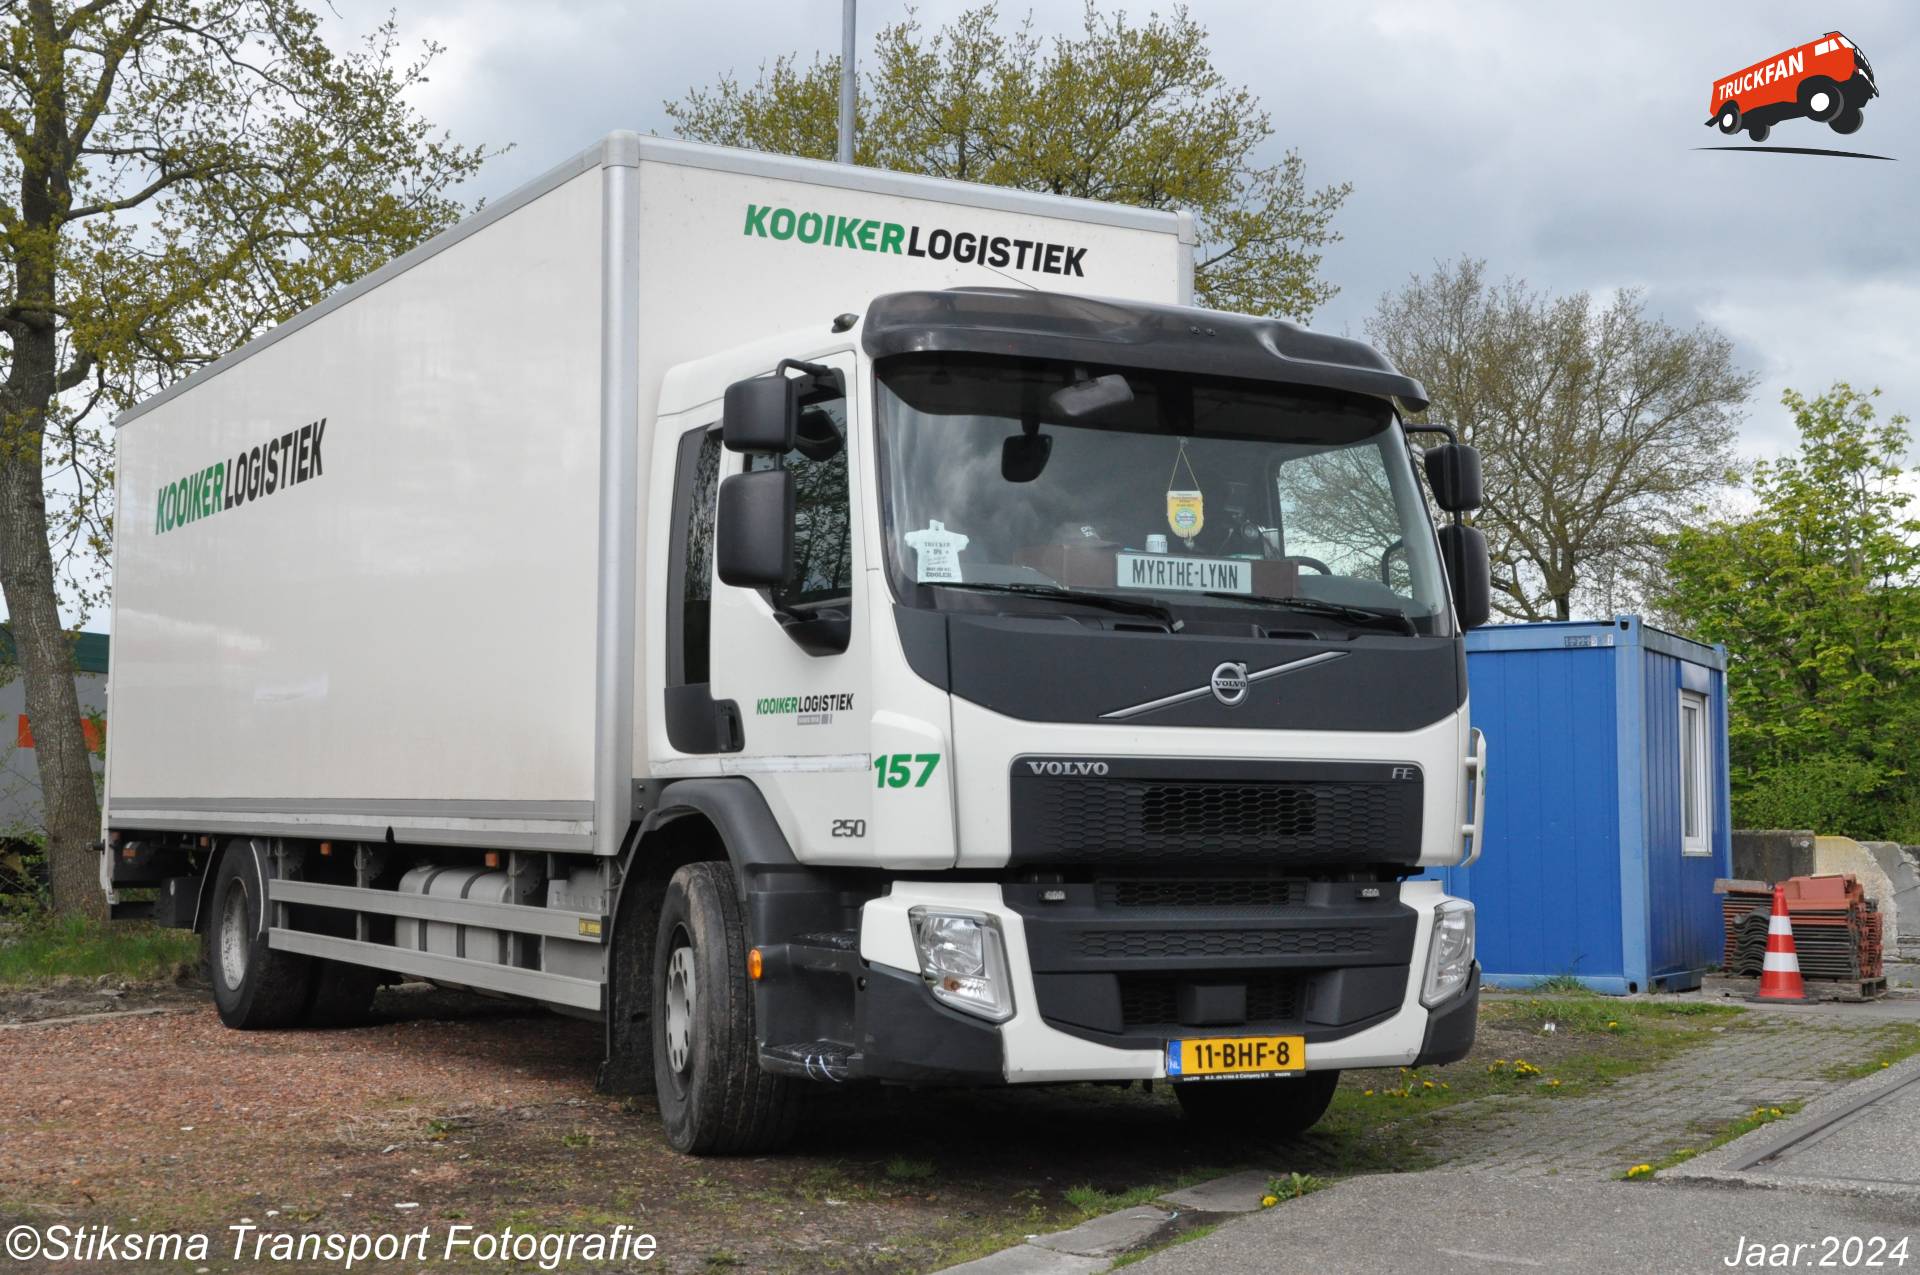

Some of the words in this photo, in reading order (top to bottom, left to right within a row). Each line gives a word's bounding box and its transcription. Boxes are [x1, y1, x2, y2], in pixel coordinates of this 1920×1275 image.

[1132, 558, 1239, 590] MYRTHE-LYNN
[1213, 680, 1246, 688] VOLVO
[873, 753, 941, 789] 157
[1027, 760, 1109, 777] VOLVO
[1391, 766, 1416, 780] FE
[831, 819, 867, 838] 250
[1169, 1059, 1180, 1069] NL
[1194, 1041, 1290, 1069] 11-BHF-8
